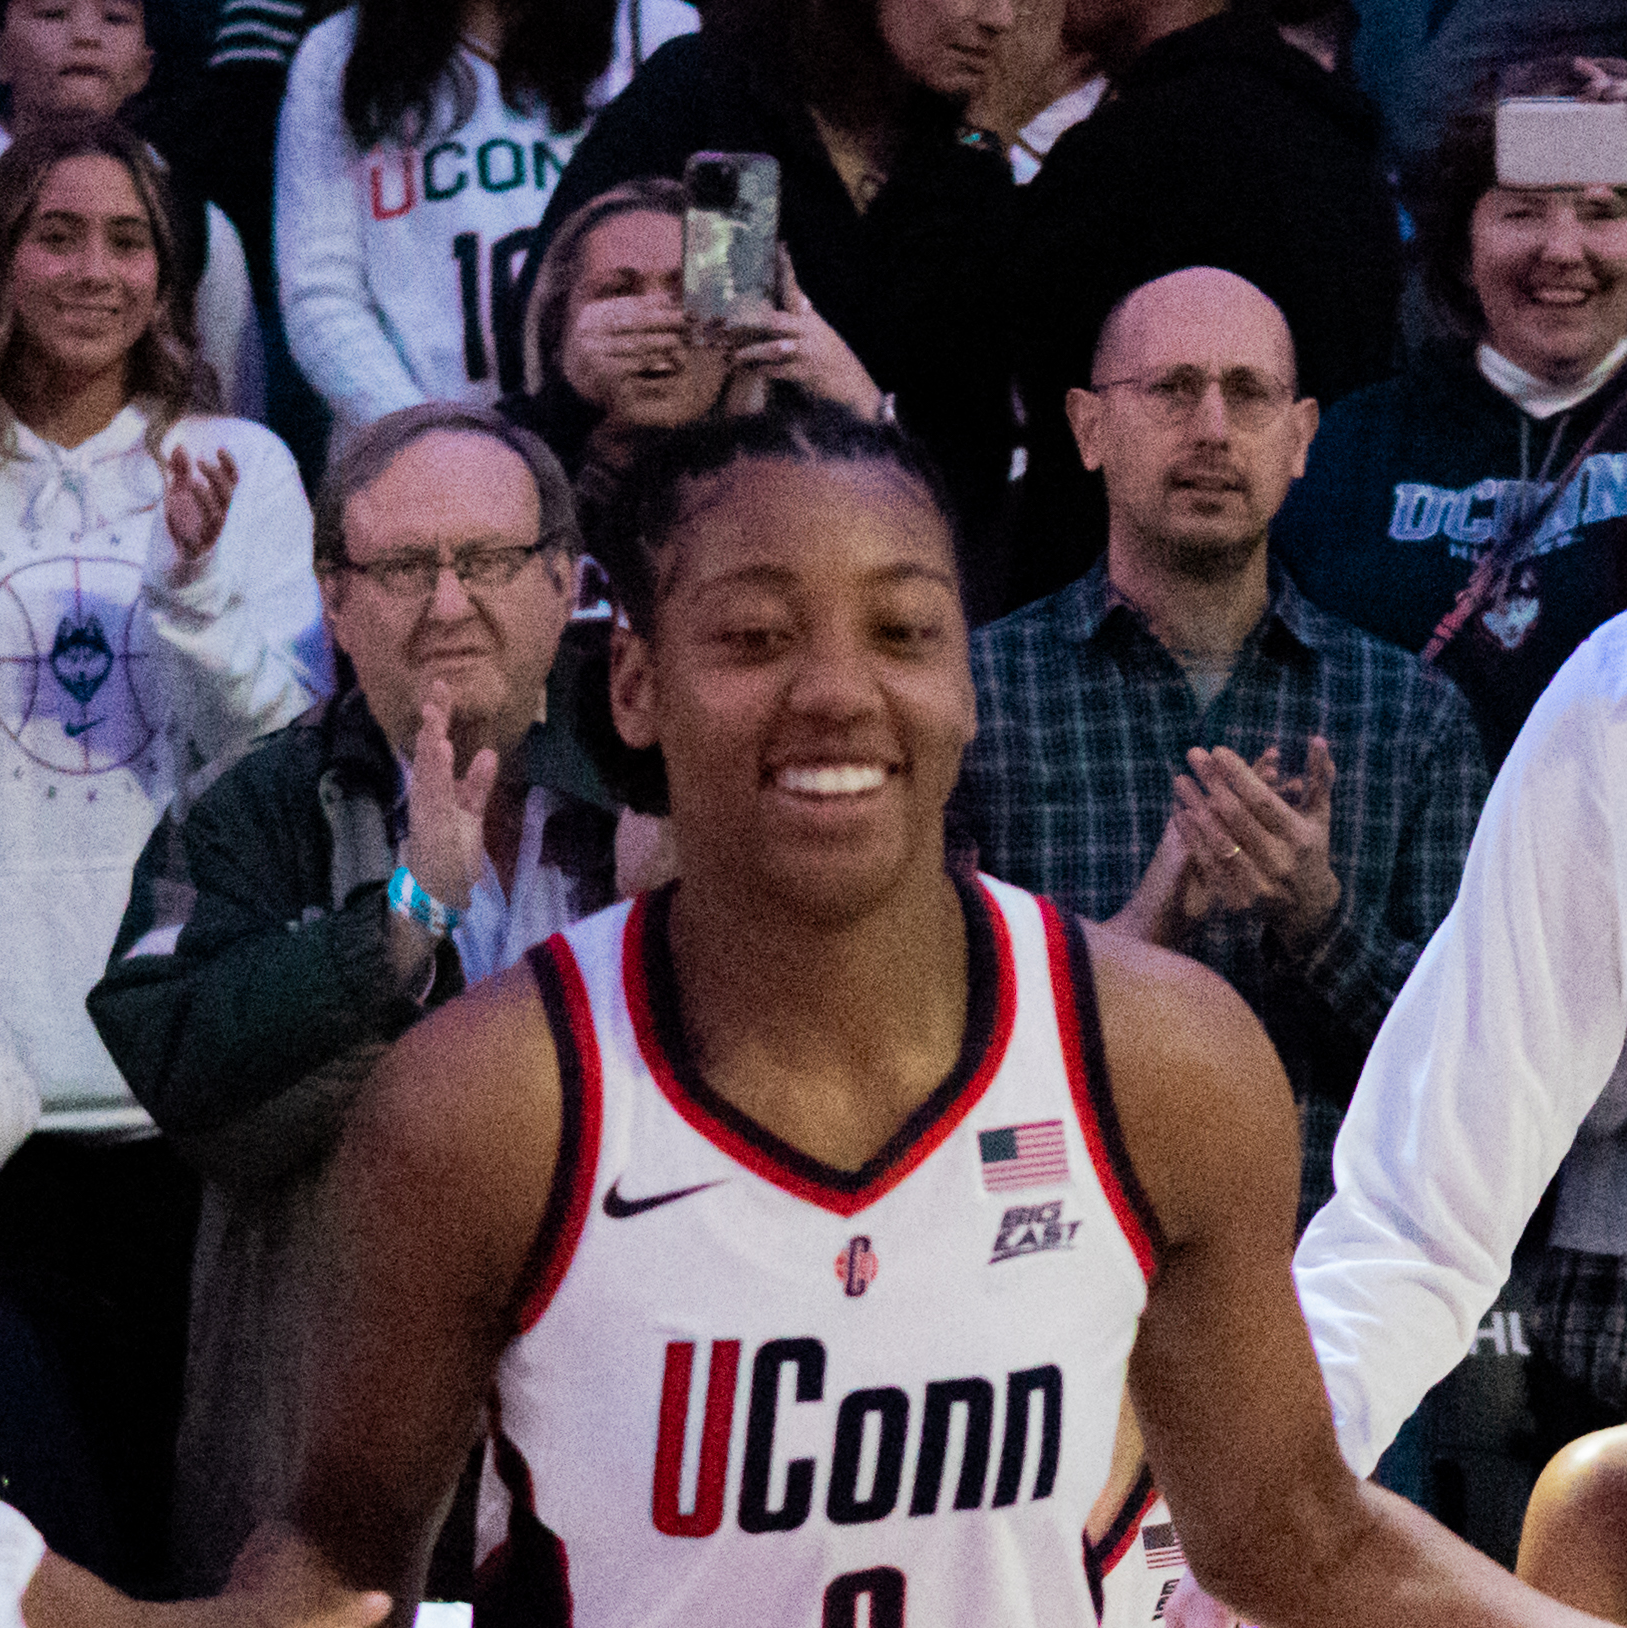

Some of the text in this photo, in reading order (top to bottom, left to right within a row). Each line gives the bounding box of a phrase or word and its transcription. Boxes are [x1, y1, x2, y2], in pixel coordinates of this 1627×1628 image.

[369, 139, 564, 222] UCON
[991, 1219, 1083, 1252] EAST
[1000, 1200, 1064, 1228] BIG
[651, 1336, 1064, 1540] UConn
